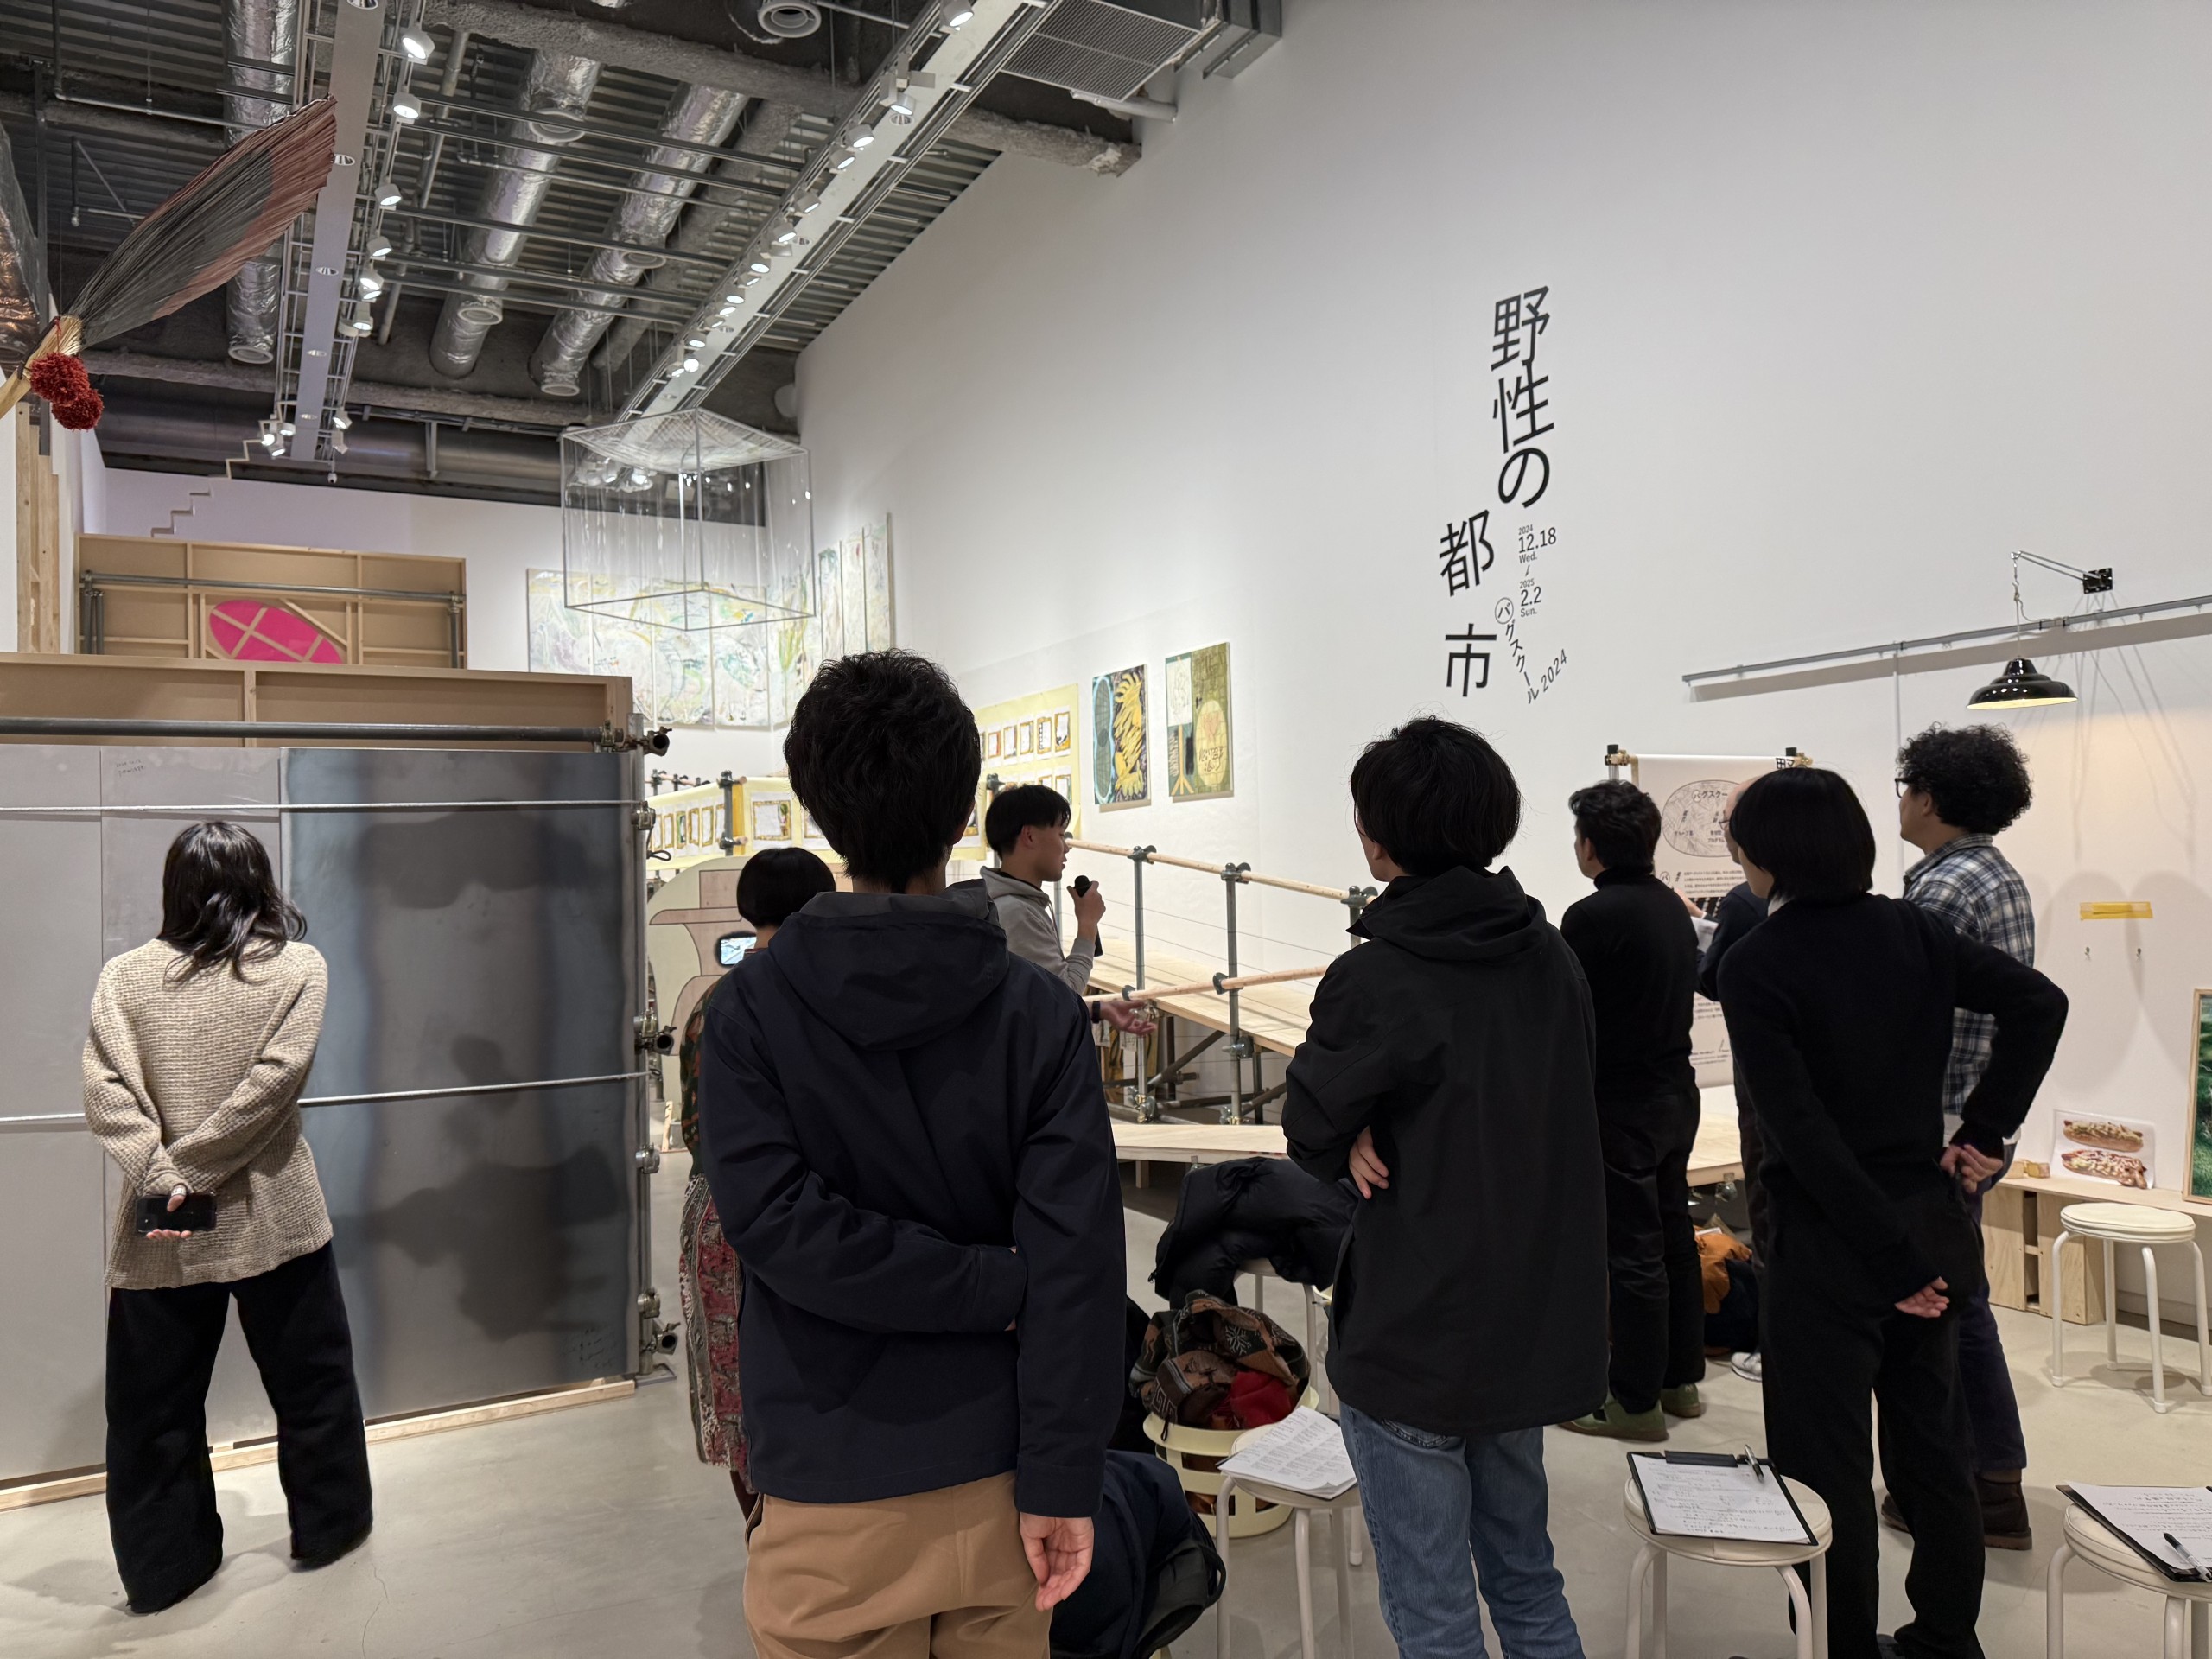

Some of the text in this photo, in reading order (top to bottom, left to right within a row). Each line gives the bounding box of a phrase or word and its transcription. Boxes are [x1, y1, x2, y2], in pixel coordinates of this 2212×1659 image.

[1491, 286, 1554, 507] 野性の
[1518, 524, 1533, 536] 2024
[1518, 527, 1556, 553] 12.18
[1519, 551, 1537, 563] Wed.
[1520, 578, 1535, 589] 2025
[1440, 509, 1497, 697] 都市
[1521, 587, 1541, 607] 2.2
[1521, 607, 1537, 618] Sun.
[1496, 599, 1567, 704] バグスクール 2024
